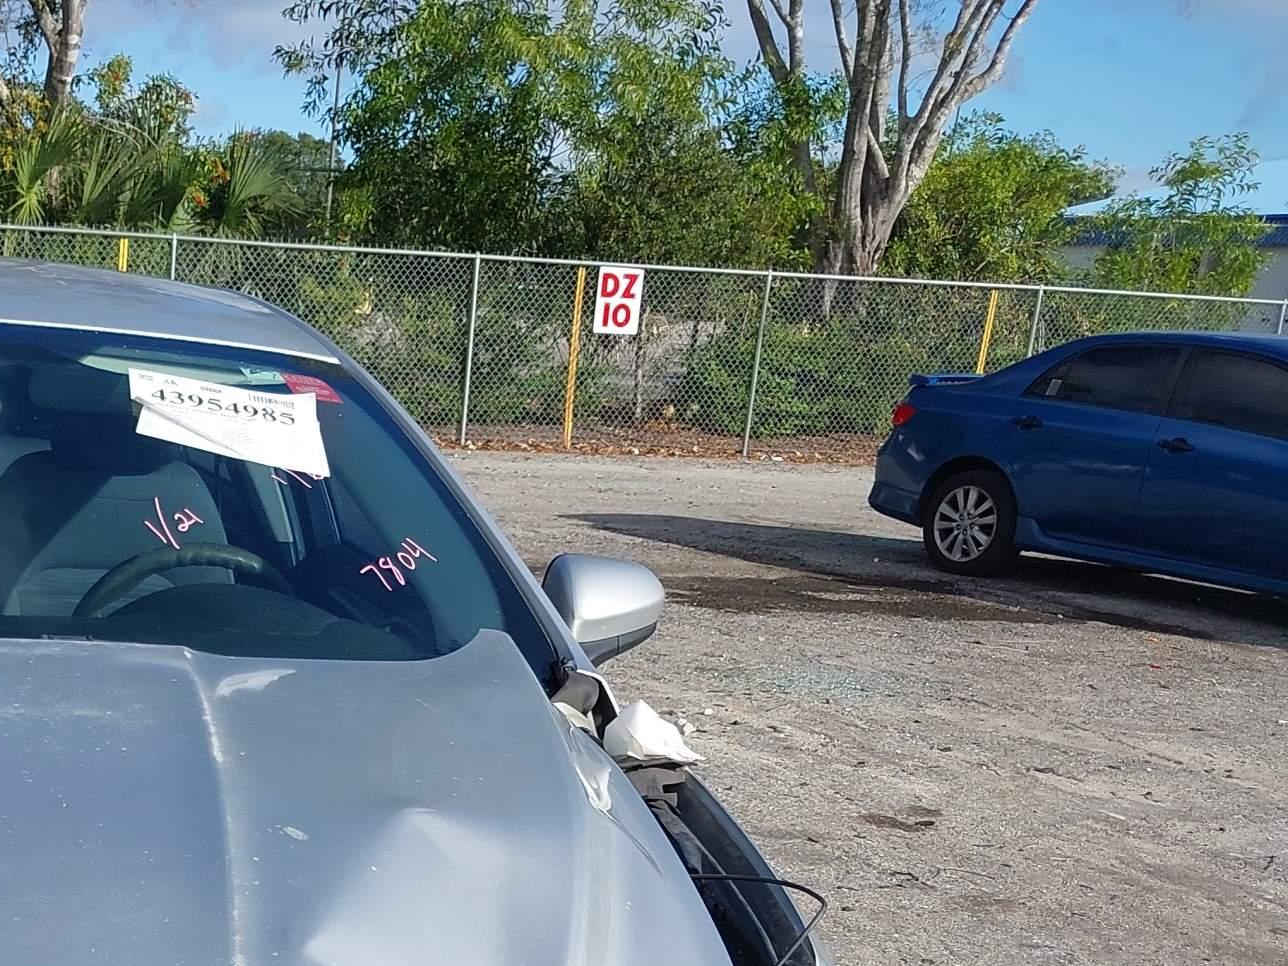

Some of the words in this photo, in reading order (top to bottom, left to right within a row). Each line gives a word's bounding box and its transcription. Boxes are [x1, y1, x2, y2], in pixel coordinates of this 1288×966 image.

[600, 272, 640, 299] DZ
[150, 388, 297, 427] 43954985
[359, 537, 439, 592] 7804
